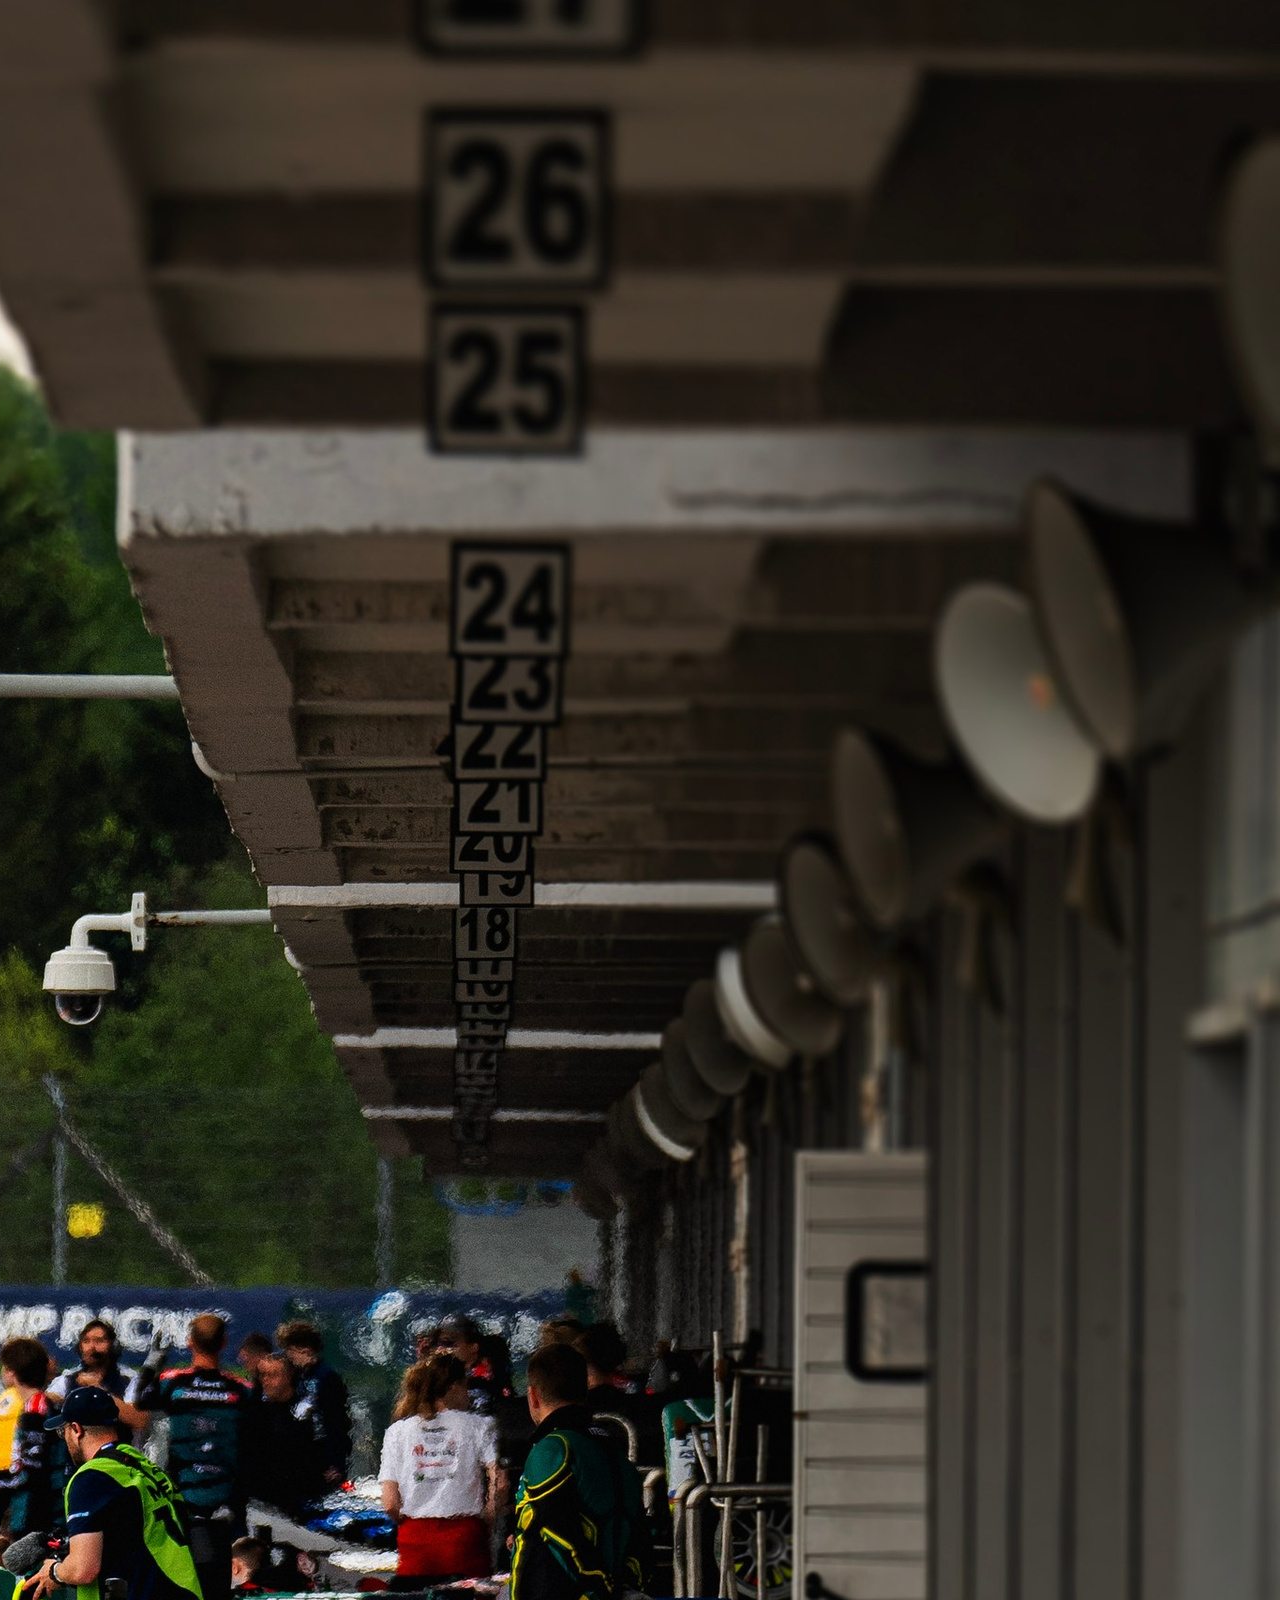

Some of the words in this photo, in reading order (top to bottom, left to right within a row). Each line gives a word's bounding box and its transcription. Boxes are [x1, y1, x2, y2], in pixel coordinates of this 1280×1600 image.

[446, 137, 590, 265] 26
[446, 328, 568, 435] 25
[462, 561, 556, 644] 24
[467, 657, 552, 711] 23
[460, 725, 536, 770] 22
[467, 782, 531, 824] 21
[460, 907, 511, 952] 18
